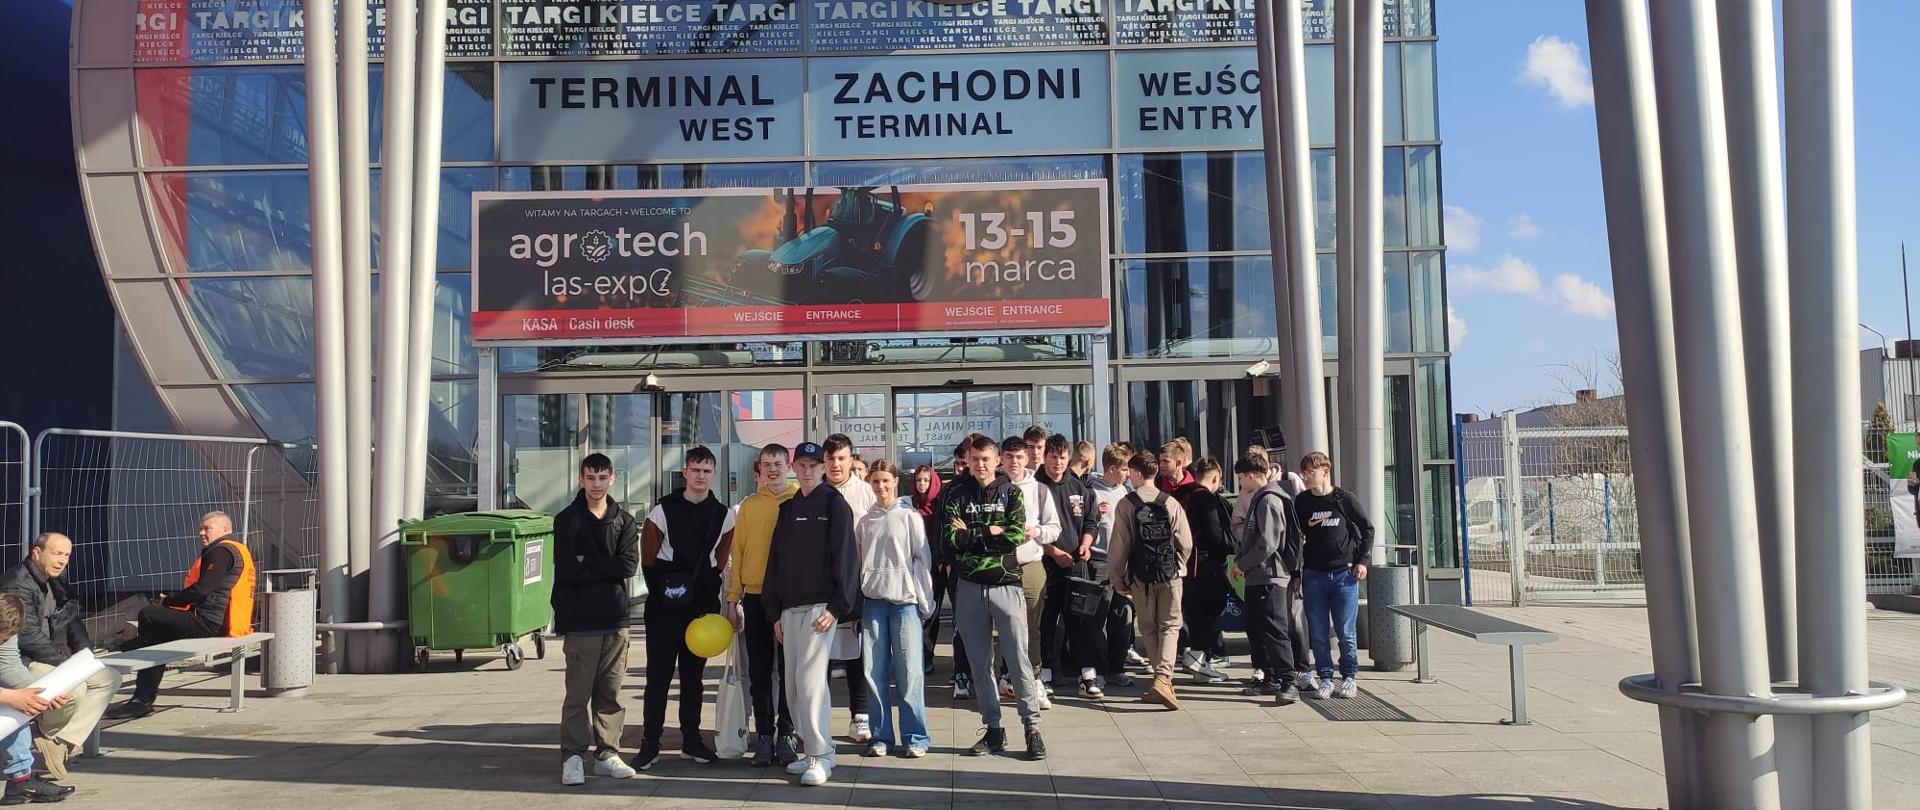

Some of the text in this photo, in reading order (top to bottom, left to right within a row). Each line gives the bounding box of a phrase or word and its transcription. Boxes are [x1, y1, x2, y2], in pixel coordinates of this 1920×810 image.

[137, 10, 280, 31] RGI TARGI
[446, 7, 488, 25] RGI
[506, 3, 796, 25] TARGI KIELCE TARGI
[815, 0, 1101, 20] TARGI KIELCE TARGI
[1123, 22, 1157, 30] KIELCE
[530, 74, 775, 109] TERMINAL
[833, 67, 1081, 104] ZACHODNI
[1139, 65, 1261, 97] WEJŚC
[834, 112, 1013, 140] TERMINAL
[1139, 105, 1257, 132] ENTRY
[679, 117, 775, 142] WEST
[524, 207, 691, 218] WITAMY NA TARGACH WELCOME TO
[959, 210, 1077, 251] 13-15
[966, 258, 1076, 284] marca
[734, 309, 862, 322] WEJŚCIE ENTRANCE
[945, 304, 1064, 318] WEJŚCIE ENTRANCE
[522, 316, 635, 331] KASA Cash desk
[1321, 518, 1341, 527] MAN
